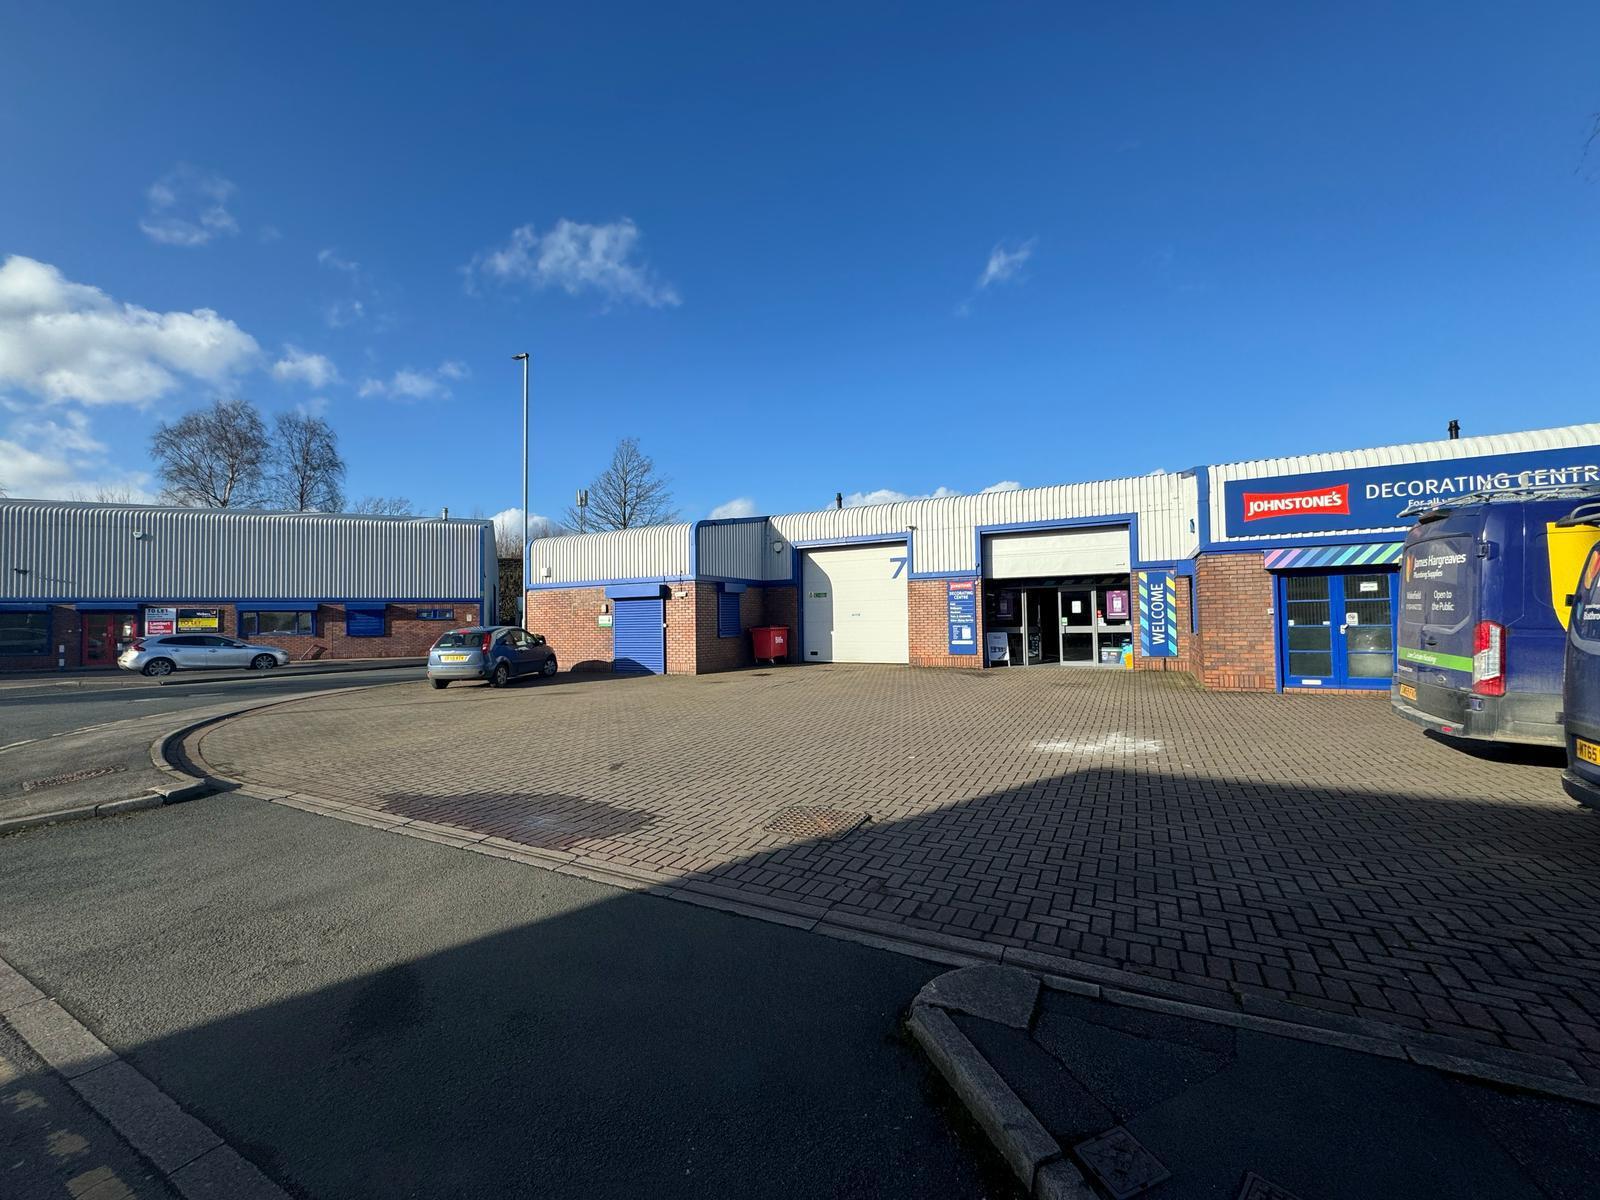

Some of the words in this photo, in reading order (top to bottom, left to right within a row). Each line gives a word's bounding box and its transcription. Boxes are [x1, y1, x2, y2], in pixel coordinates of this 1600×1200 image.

[1366, 474, 1510, 499] DECORATING
[1247, 491, 1342, 516] JOHNSTONE'S
[889, 557, 908, 579] 7
[1428, 554, 1466, 568] Hargreaves
[1433, 590, 1446, 601] Open
[1446, 591, 1453, 599] to
[1440, 602, 1454, 610] Public
[1150, 583, 1165, 645] WELCOME
